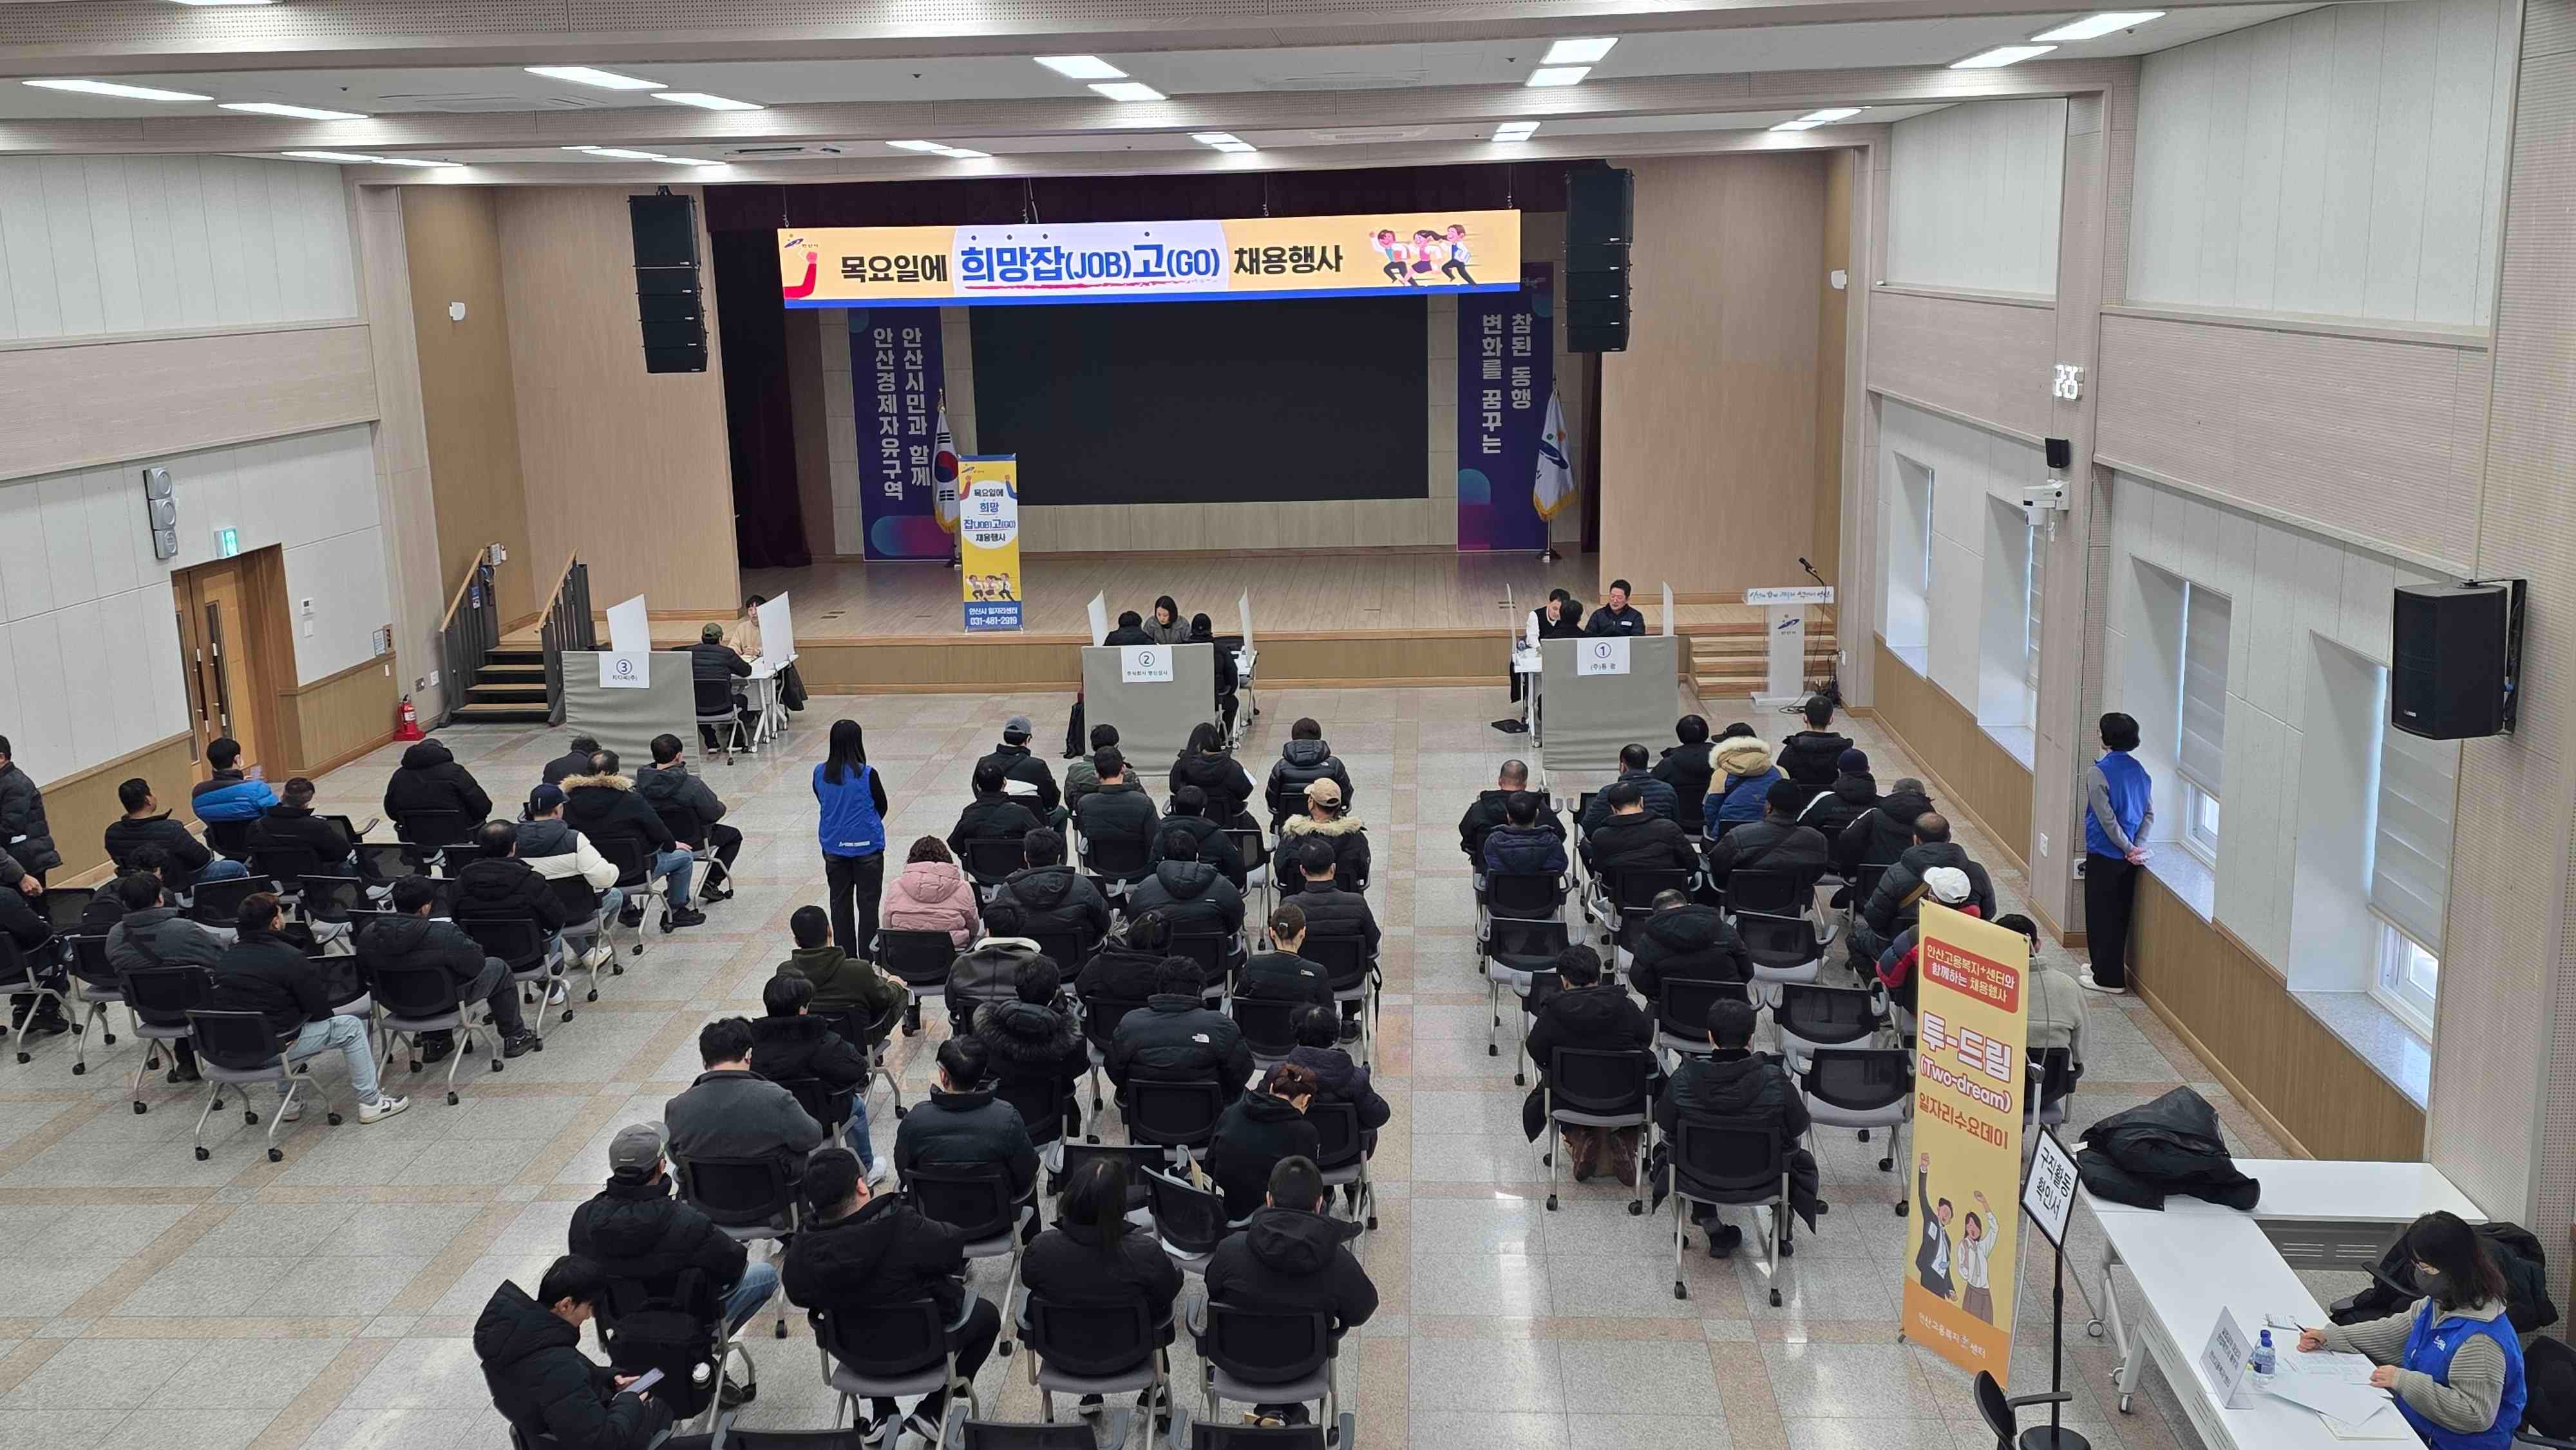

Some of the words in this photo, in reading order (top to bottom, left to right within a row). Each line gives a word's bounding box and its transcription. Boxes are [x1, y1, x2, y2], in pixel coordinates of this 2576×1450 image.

[841, 254, 947, 283] 목요일에
[961, 244, 1220, 283] 희망잡(JOB)고(GO)
[1234, 244, 1343, 276] 채용행사
[1482, 314, 1503, 380] 변화를
[1511, 314, 1533, 357] 참된
[902, 328, 928, 436] 안산시민과
[1511, 366, 1531, 410] 동행
[873, 327, 903, 500] 안산경제자유구역
[1482, 389, 1502, 454] 꿈꾸는
[909, 444, 931, 487] 함께
[974, 489, 1004, 497] 목요일에
[980, 502, 999, 513] 희망
[963, 518, 1016, 529] 잡(JOB)고(GO)
[976, 533, 1006, 541] 채용행사
[988, 607, 1018, 615] 일자리센터
[1926, 943, 2015, 990] 안산고용복지+센터와
[1931, 961, 1969, 988] 함께하는
[1969, 976, 2008, 1003] 채용행사
[1922, 1010, 2012, 1083] 투-드림
[1919, 1053, 2012, 1114] (Two-dream)
[1918, 1091, 2009, 1151] 일자리수요데이
[2040, 1146, 2072, 1198] 구직활동
[2036, 1176, 2061, 1221] 확인서
